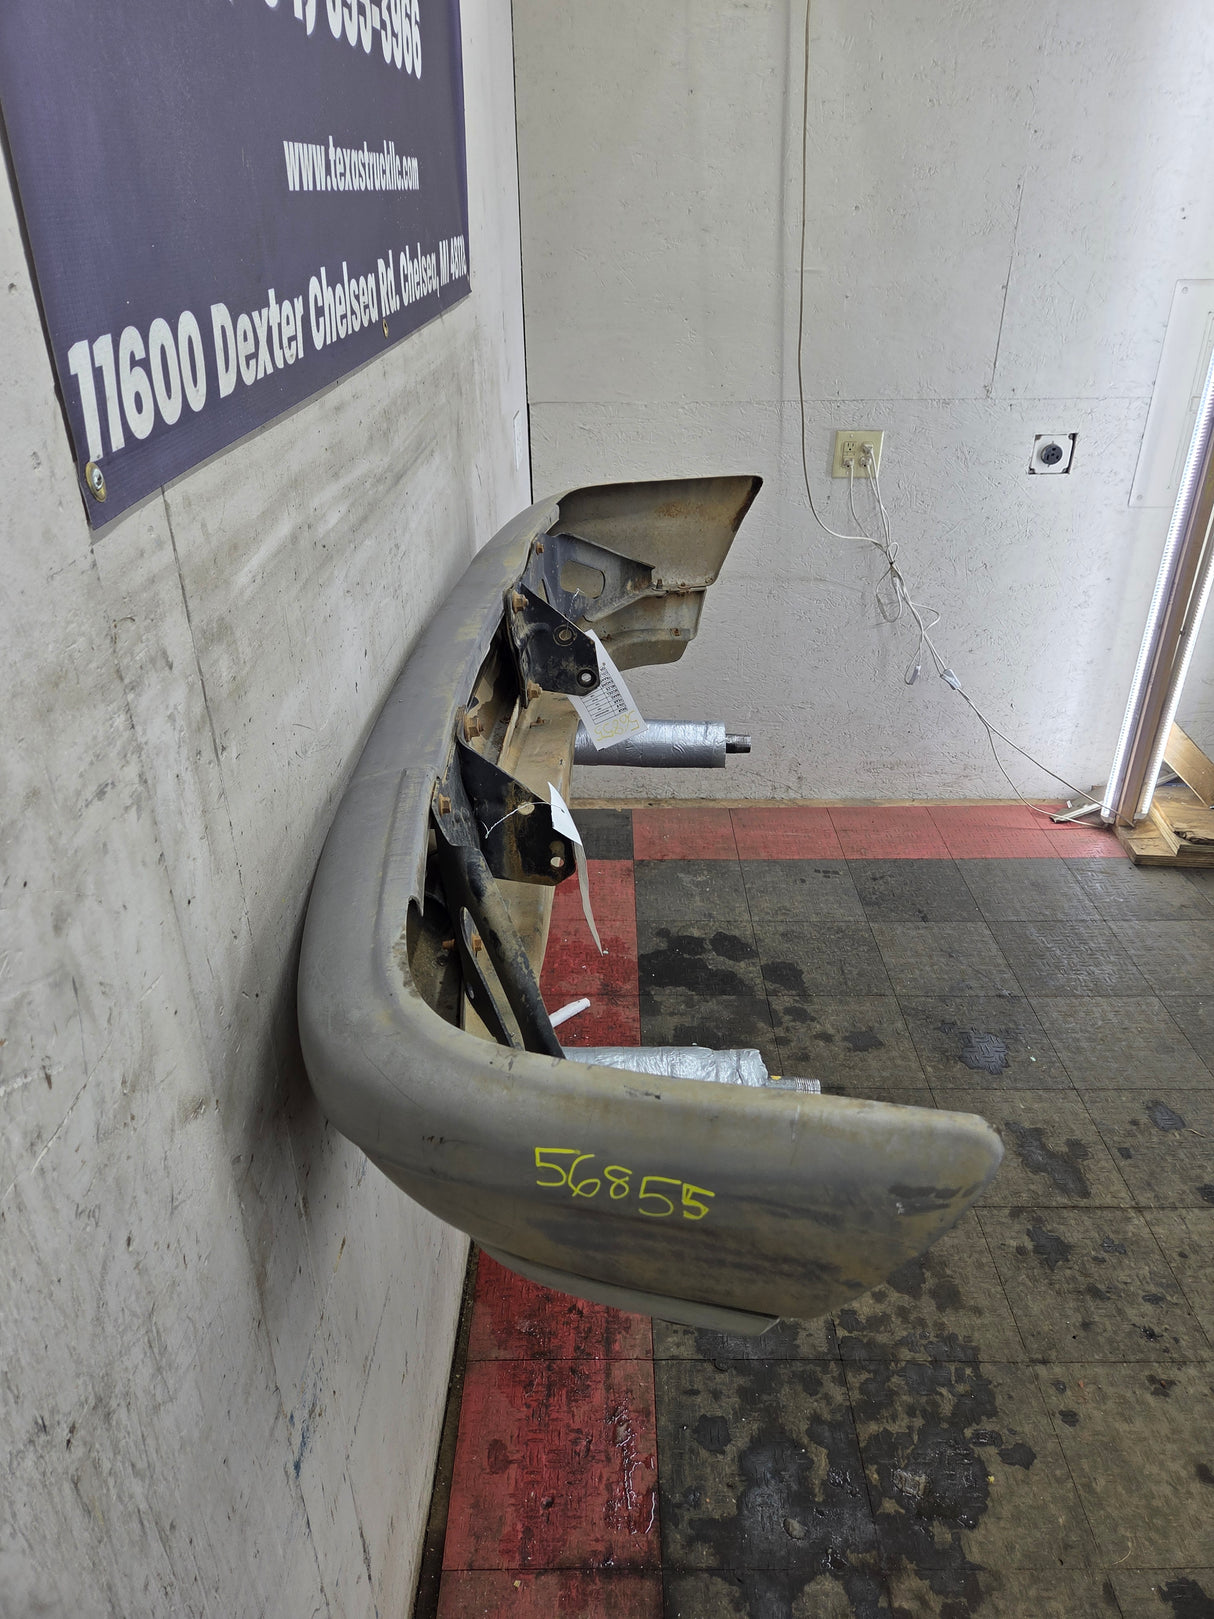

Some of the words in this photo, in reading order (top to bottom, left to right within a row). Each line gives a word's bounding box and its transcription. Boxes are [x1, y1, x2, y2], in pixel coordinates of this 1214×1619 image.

[283, 135, 419, 192] www.texastruckllc.com
[67, 310, 207, 463] 11600
[210, 288, 304, 398] Dexter
[308, 261, 379, 350] Chelsea
[377, 249, 400, 318] Rd.
[400, 242, 440, 306] Chelsea,
[439, 239, 450, 287] MI
[593, 710, 640, 742] 56855
[534, 1147, 715, 1220] 56855
